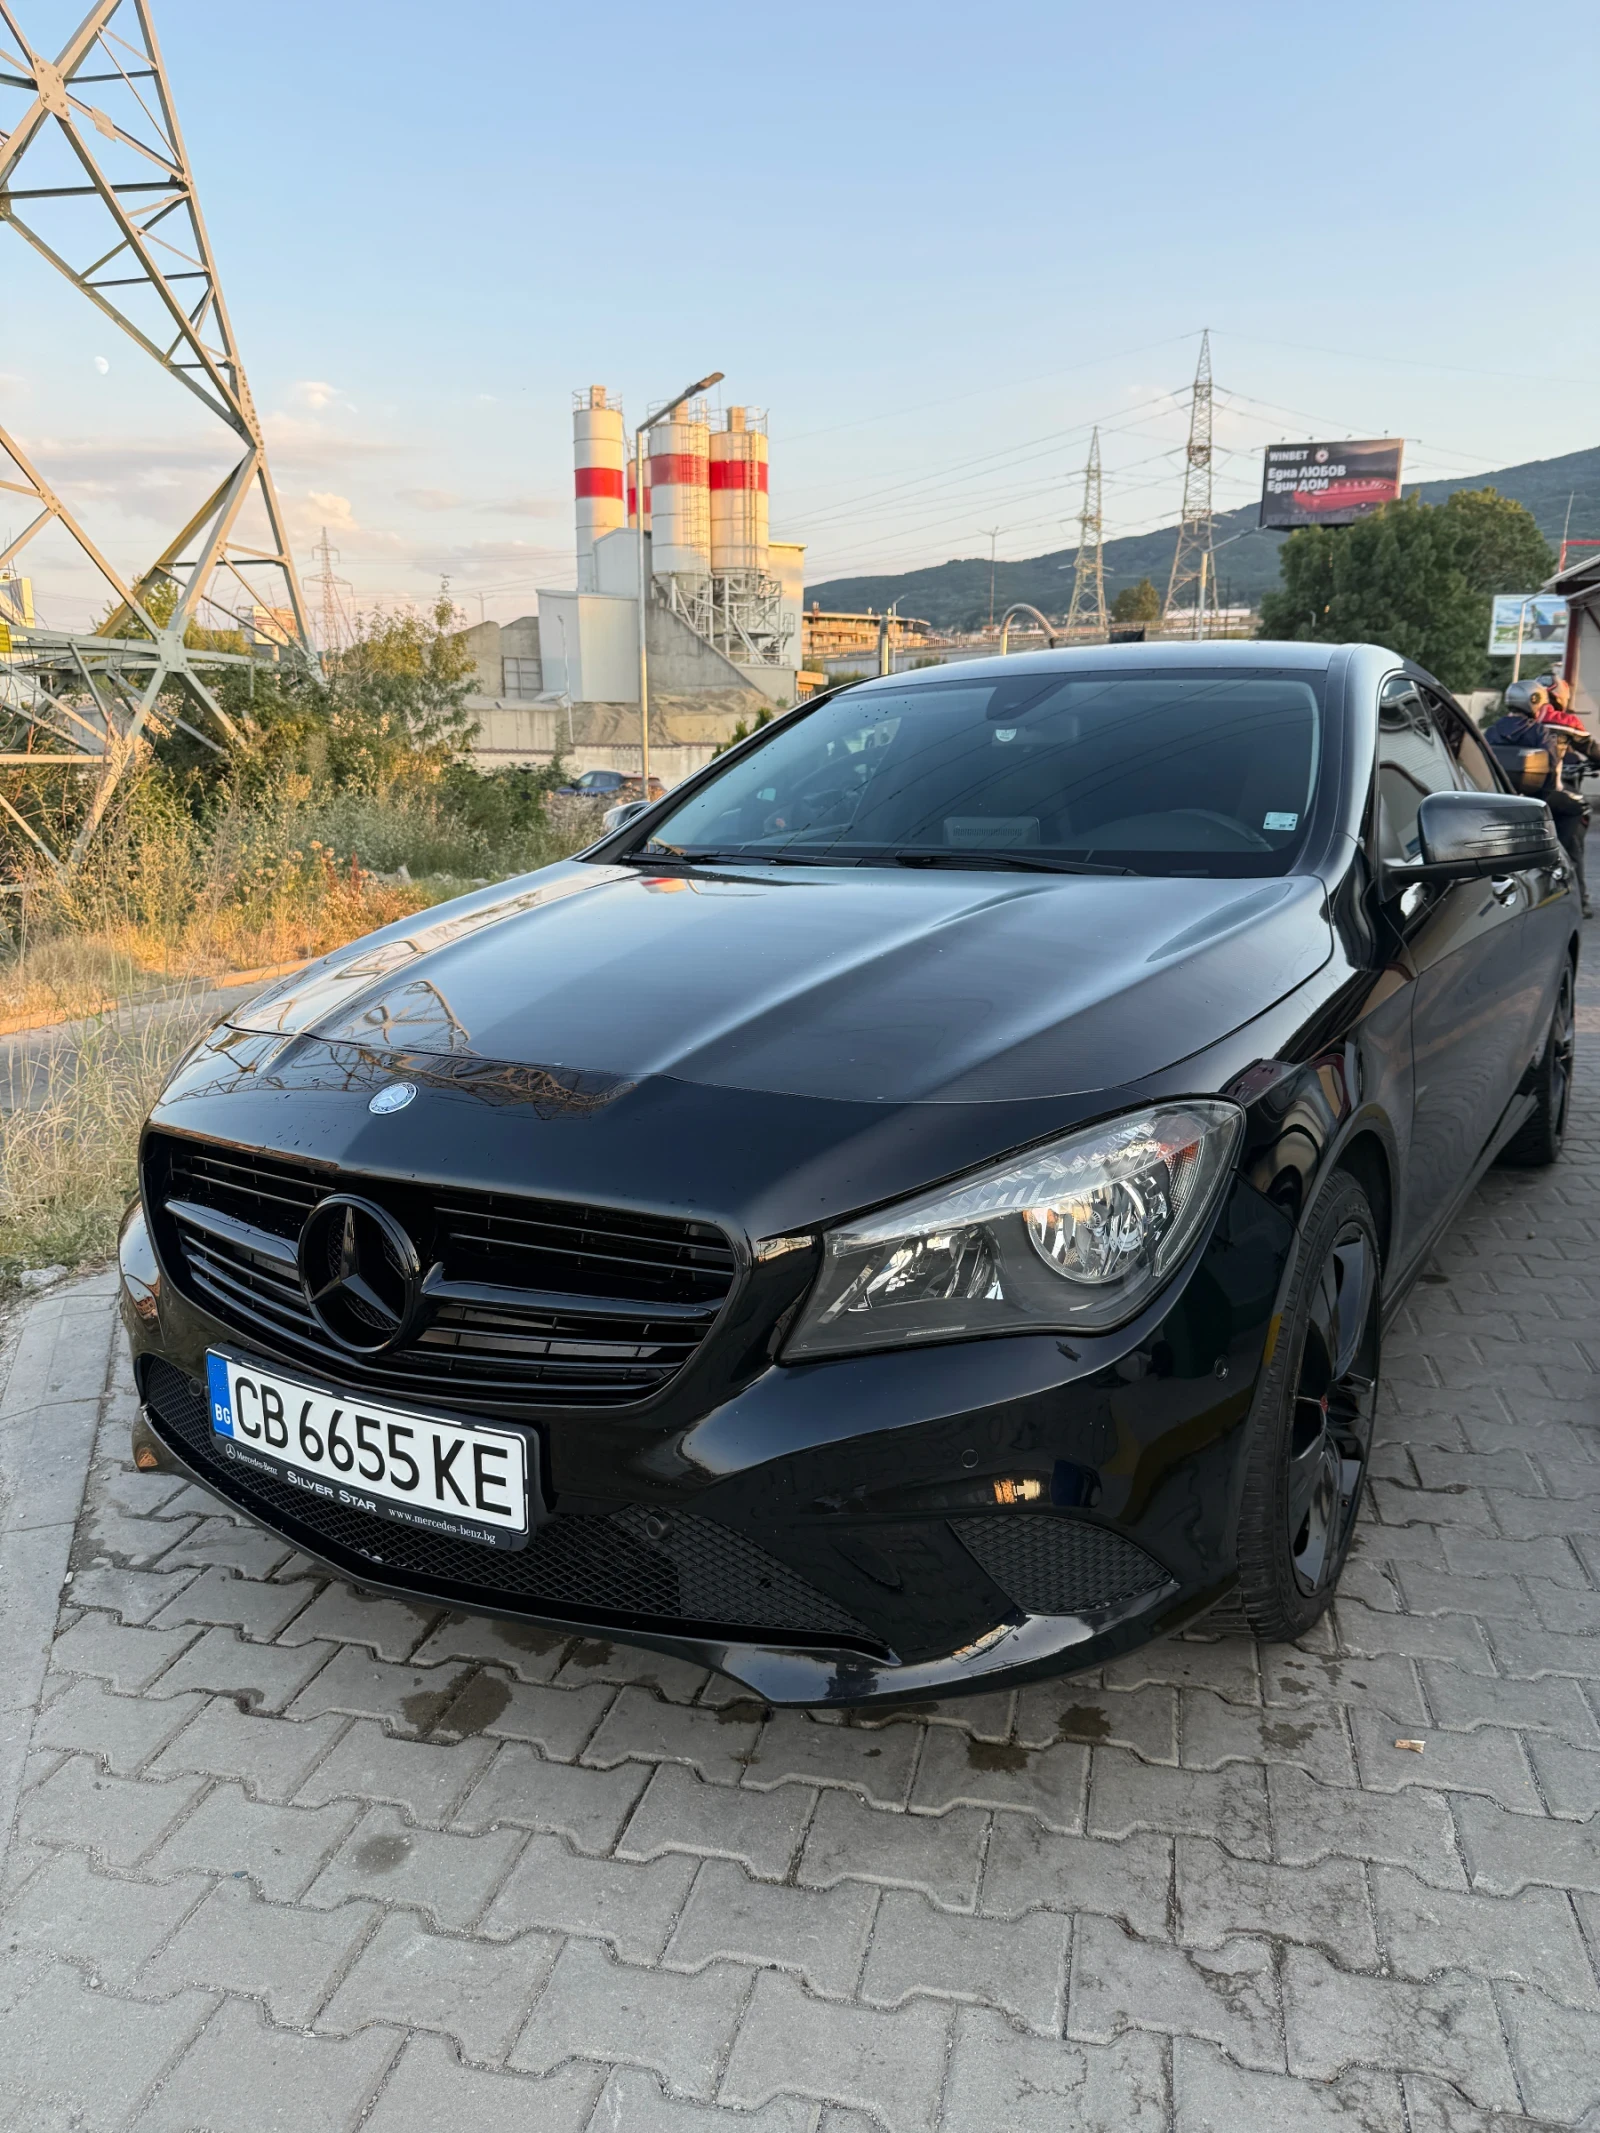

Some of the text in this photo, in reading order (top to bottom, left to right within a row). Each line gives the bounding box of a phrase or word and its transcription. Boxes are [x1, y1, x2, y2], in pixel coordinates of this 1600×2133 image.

[1269, 450, 1309, 461] WINBET
[1268, 465, 1346, 480] Една ЛЮБОВ
[1267, 479, 1329, 494] Един ДОМ
[214, 1403, 231, 1425] BG
[234, 1376, 512, 1517] CB 6655 KE
[236, 1450, 278, 1476] Mercedes-Benz
[388, 1507, 496, 1545] www.mercedes-benz.bg
